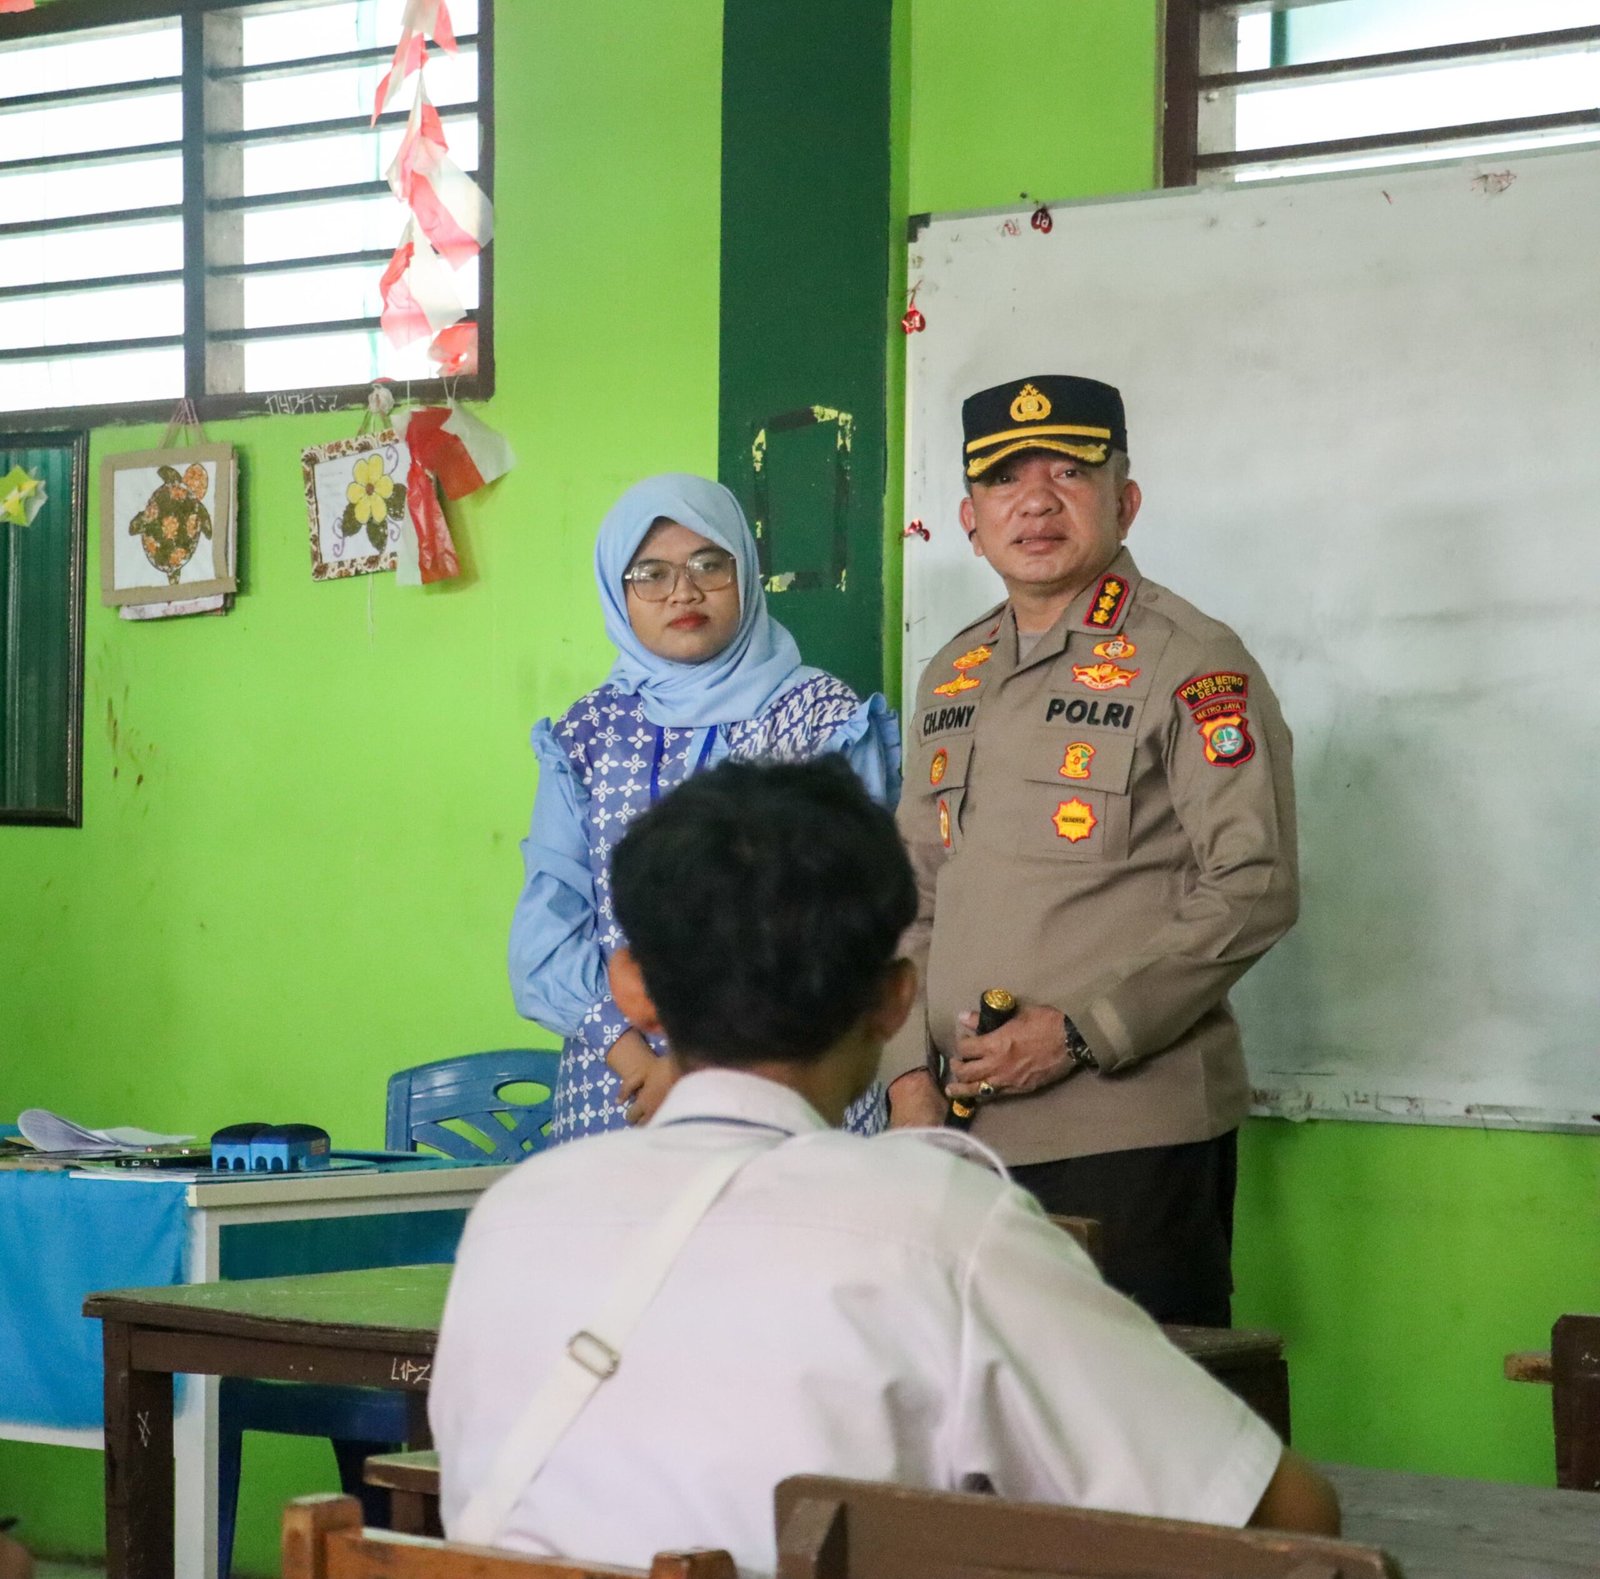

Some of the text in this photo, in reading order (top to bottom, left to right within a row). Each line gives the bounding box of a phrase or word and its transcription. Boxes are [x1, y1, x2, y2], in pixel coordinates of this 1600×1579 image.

[1180, 675, 1244, 699] POLRES METRO
[1198, 685, 1232, 699] DEPOK
[923, 705, 975, 737] CH.RONY
[1045, 698, 1134, 729] POLRI
[1196, 703, 1241, 720] METRO JAYA
